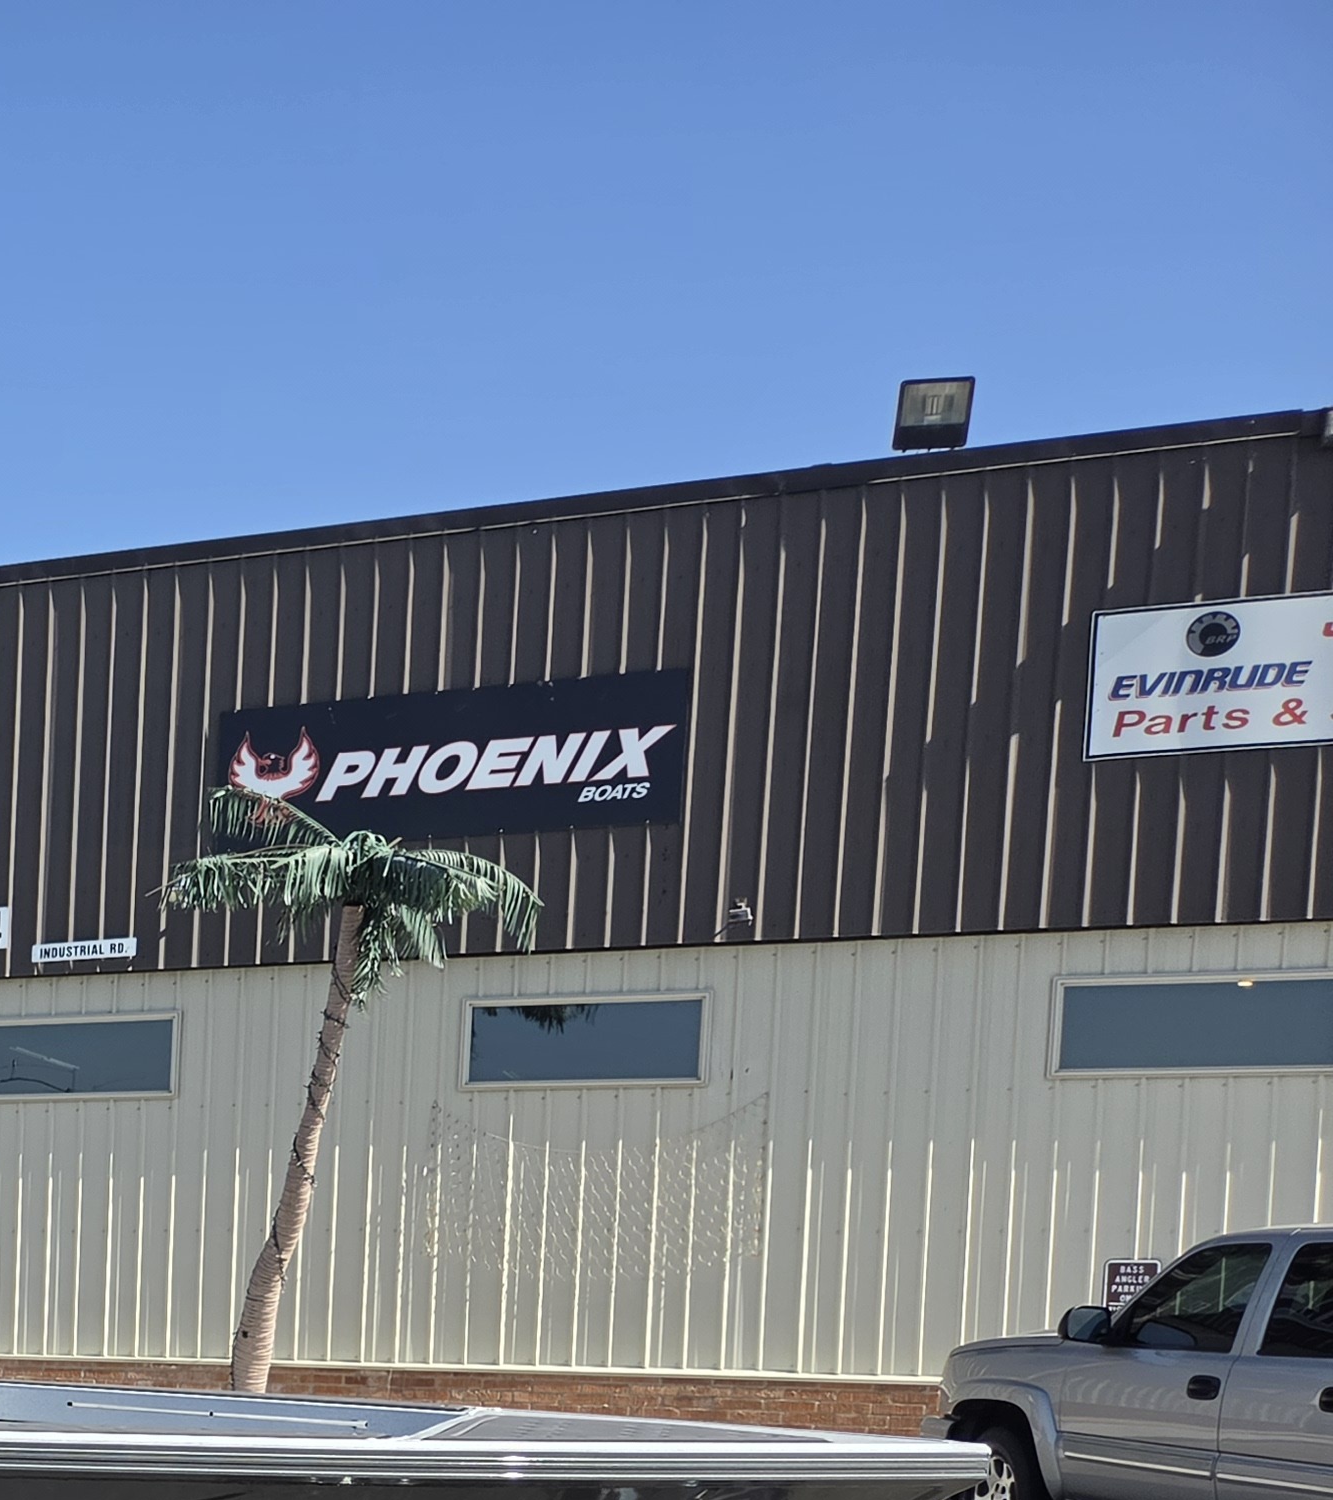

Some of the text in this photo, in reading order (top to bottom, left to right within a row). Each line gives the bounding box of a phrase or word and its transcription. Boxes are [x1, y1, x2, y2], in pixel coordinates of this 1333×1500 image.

[1204, 634, 1238, 645] BRP
[1108, 660, 1313, 701] EVINRUDE
[1112, 698, 1309, 738] Parts &
[315, 725, 677, 803] PHOENIX
[577, 781, 651, 804] BOATS
[39, 942, 129, 959] INDUSTRIAL RD.
[1119, 1265, 1145, 1274] BASS
